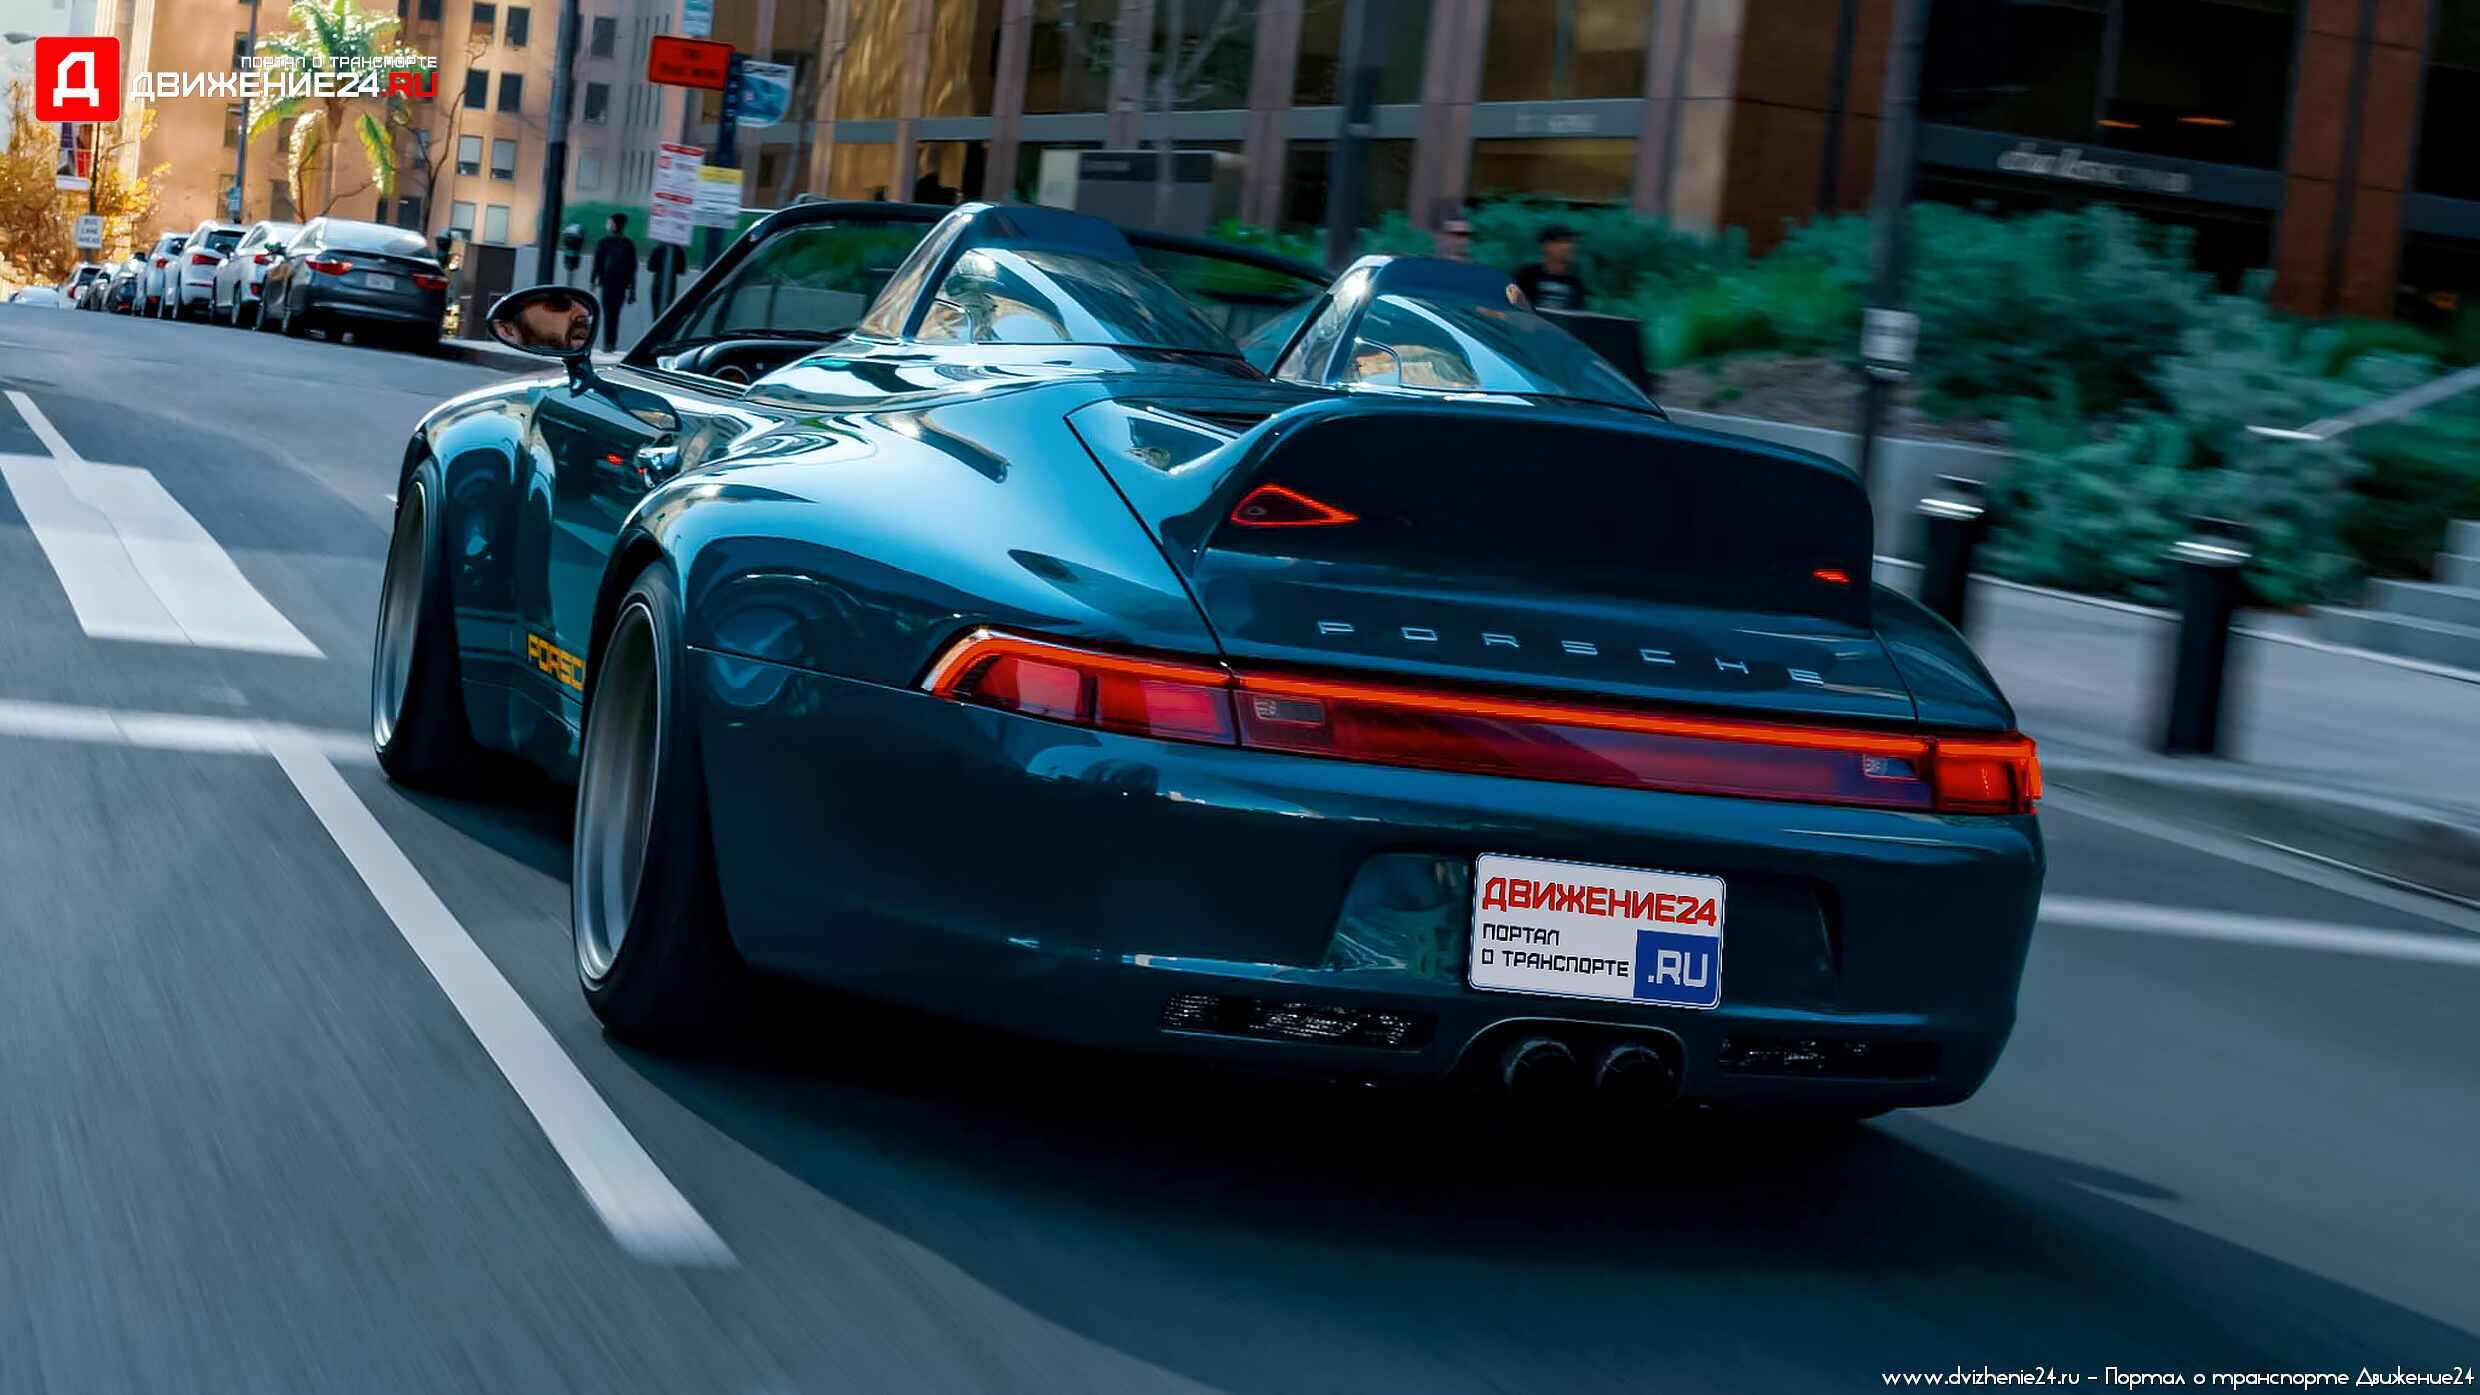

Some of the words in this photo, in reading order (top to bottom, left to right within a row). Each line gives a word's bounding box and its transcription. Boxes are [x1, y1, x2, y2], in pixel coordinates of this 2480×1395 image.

[1317, 620, 1825, 688] PORSCHE
[1481, 876, 1717, 927] ДВИЖЕНИЕ24
[1482, 923, 1560, 947] ПОРТАЛ
[1501, 949, 1630, 978] ТРАНСПОРТЕ
[1647, 948, 1709, 988] .RU
